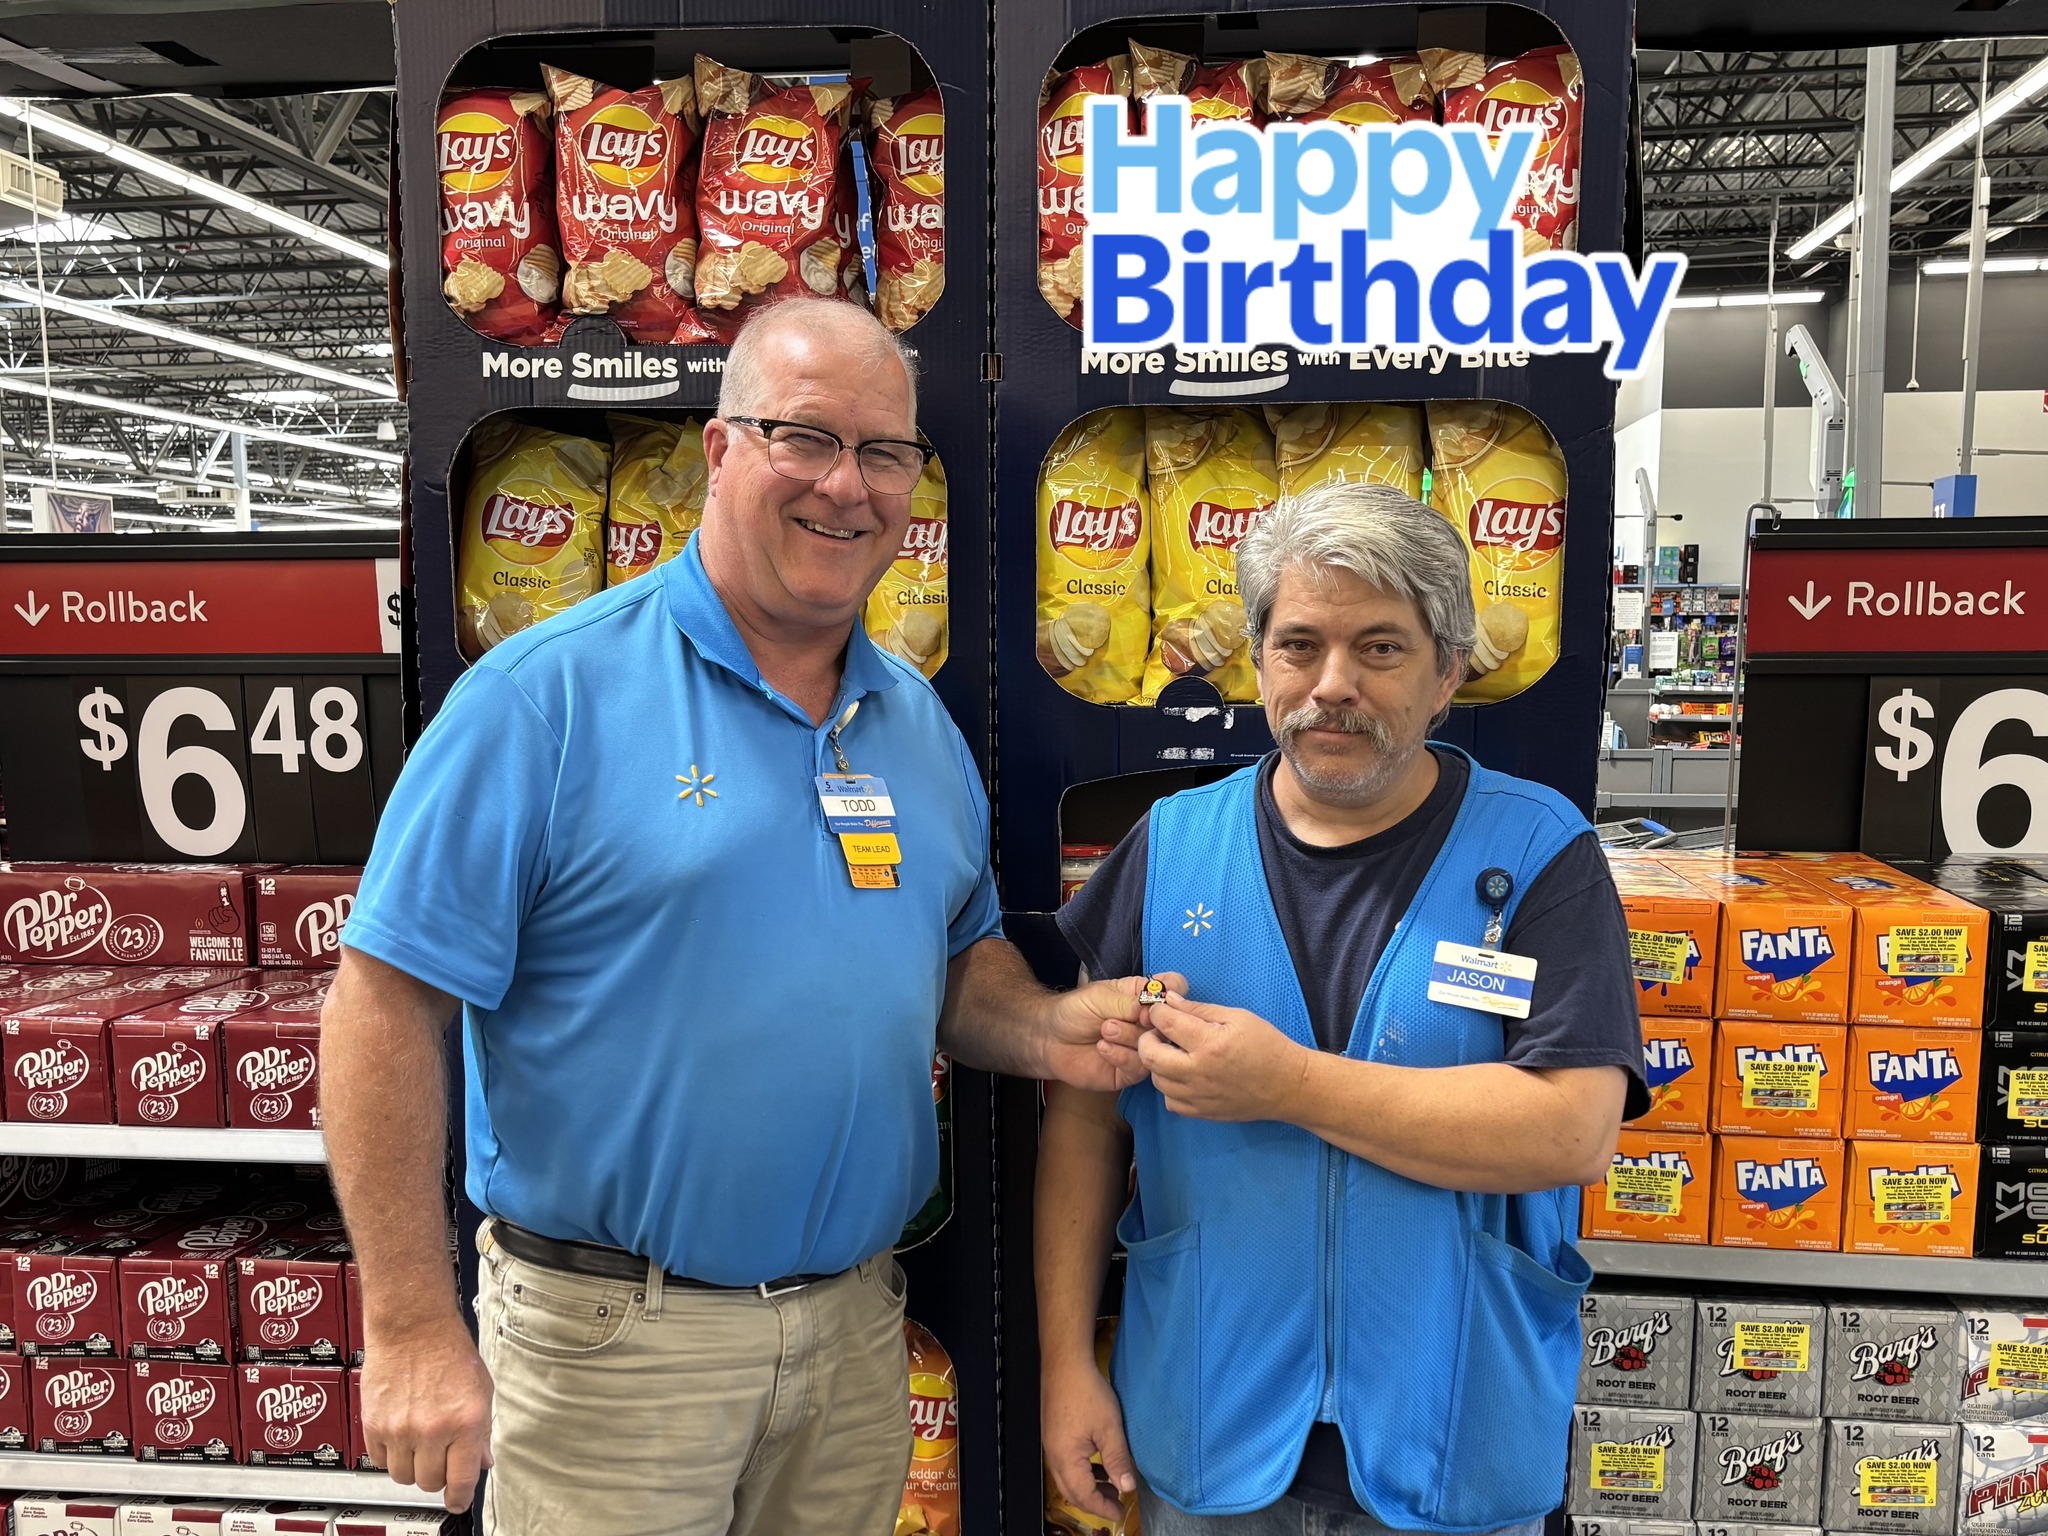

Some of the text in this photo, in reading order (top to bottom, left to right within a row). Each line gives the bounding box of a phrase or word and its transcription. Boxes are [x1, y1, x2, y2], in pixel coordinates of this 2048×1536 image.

[440, 130, 512, 174] Lay's
[587, 124, 662, 169] Lay's
[741, 130, 814, 168] Lay's
[573, 190, 677, 232] wavy
[719, 189, 824, 230] wavy
[441, 199, 530, 239] wavy
[742, 221, 794, 235] Original
[455, 236, 506, 251] Original
[482, 352, 563, 379] More
[572, 351, 678, 379] Smiles
[1081, 348, 1530, 375] More Smiles with Every Bite
[486, 496, 577, 547] Lay's
[1056, 502, 1137, 551] Lay's
[1475, 500, 1565, 553] Lay's
[493, 571, 551, 589] Classic
[1066, 579, 1126, 596] Classic
[1483, 580, 1547, 599] Classic
[897, 590, 949, 606] Classi
[1847, 580, 2026, 616] Rollback
[62, 590, 208, 624] Rollback
[837, 785, 865, 794] Walmart
[841, 799, 876, 813] TODD
[853, 845, 890, 854] TEAM LEAD
[259, 878, 276, 891] 12
[39, 890, 78, 924] Dr
[4, 898, 103, 953] Pepper
[2004, 914, 2023, 925] 12
[262, 925, 274, 934] 150
[1918, 928, 1941, 936] $2.00
[121, 927, 145, 950] 23
[189, 936, 243, 948] WELCOME TO
[1640, 933, 1683, 945] $2.00 NOW
[1741, 928, 1832, 961] FANTA
[190, 949, 244, 962] FANSVILLE
[1461, 954, 1499, 970] Walmart
[1447, 969, 1506, 992] JASON
[5, 1020, 20, 1030] 12
[194, 1025, 209, 1035] 12
[1995, 1031, 2013, 1042] 12
[40, 1048, 66, 1066] Dr
[156, 1051, 181, 1068] Dr
[263, 1046, 291, 1064] Dr
[1643, 1040, 1692, 1069] NTA
[15, 1052, 84, 1089] Pepper
[131, 1057, 199, 1091] Pepper
[237, 1051, 309, 1090] Pepper
[1750, 1063, 1815, 1072] SAVE $2.00 NOW
[1870, 1050, 1960, 1083] FANTA
[39, 1098, 54, 1111] 23
[150, 1100, 165, 1115] 23
[262, 1100, 278, 1114] 23
[1992, 1147, 2010, 1158] 12
[1614, 1167, 1633, 1175] SAVE
[1660, 1170, 1677, 1178] NOW
[1737, 1160, 1825, 1191] FANTA
[1882, 1177, 1947, 1186] SAVE $2.00 NOW
[16, 1257, 31, 1267] 12
[203, 1264, 218, 1274] 12
[240, 1260, 255, 1271] 12
[50, 1272, 76, 1290] Dr
[162, 1276, 187, 1296] Dr
[275, 1275, 300, 1295] Dr
[27, 1276, 92, 1311] Pepper
[138, 1281, 203, 1315] Pepper
[251, 1281, 316, 1315] Pepper
[1707, 1306, 1727, 1322] 12
[1840, 1312, 1860, 1327] 12
[47, 1318, 62, 1332] 23
[158, 1321, 173, 1335] 23
[271, 1323, 286, 1337] 23
[1741, 1325, 1760, 1333] SAVE
[1787, 1326, 1805, 1334] NOW
[1968, 1318, 1989, 1334] 12
[1587, 1311, 1671, 1367] Barq's
[1850, 1325, 1937, 1381] Barq's
[1997, 1344, 2042, 1354] SAVE $2.00
[135, 1362, 149, 1372] 12
[245, 1368, 259, 1378] 12
[68, 1370, 93, 1389] Dr
[170, 1378, 194, 1397] Dr
[1596, 1379, 1656, 1391] ROOT BEER
[45, 1374, 109, 1408] Pepper
[146, 1382, 210, 1416] Pepper
[280, 1383, 304, 1403] Dr
[1726, 1389, 1787, 1400] ROOT BEER
[256, 1387, 321, 1422] Pepper
[1857, 1394, 1920, 1405] ROOT BEER
[65, 1416, 80, 1429] 23
[910, 1395, 957, 1440] ay's
[1582, 1411, 1600, 1426] 12
[1709, 1417, 1728, 1431] 12
[166, 1423, 181, 1437] 23
[276, 1428, 290, 1442] 23
[1844, 1426, 1864, 1440] 12
[1619, 1447, 1640, 1455] $2.00
[1973, 1436, 1995, 1451] 12
[1719, 1430, 1803, 1486] Barq's
[947, 1467, 956, 1479] &
[1600, 1492, 1659, 1503] ROOT BEER
[1728, 1498, 1787, 1508] ROOT BEER
[1857, 1508, 1919, 1519] ROOT BEER
